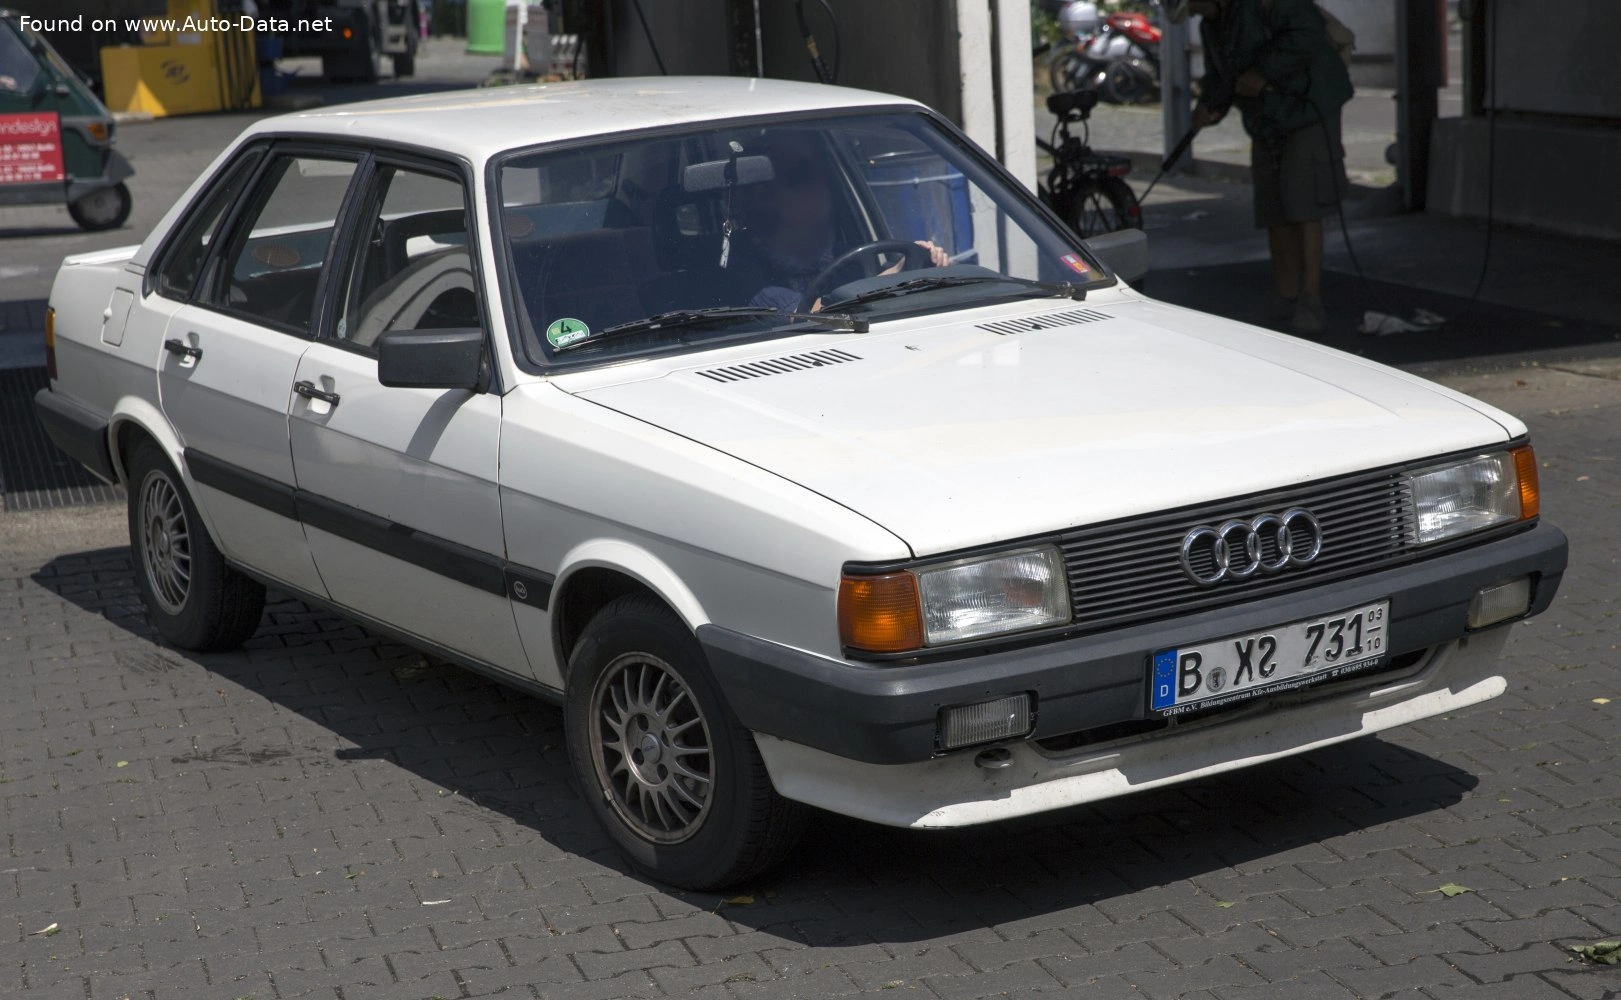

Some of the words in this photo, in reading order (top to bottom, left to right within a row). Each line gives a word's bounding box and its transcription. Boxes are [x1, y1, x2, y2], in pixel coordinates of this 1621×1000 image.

[560, 321, 572, 333] 4
[1368, 608, 1383, 622] 03
[1366, 637, 1381, 651] 10
[1178, 651, 1203, 698] B
[1304, 612, 1364, 667] 731
[1160, 684, 1169, 698] D
